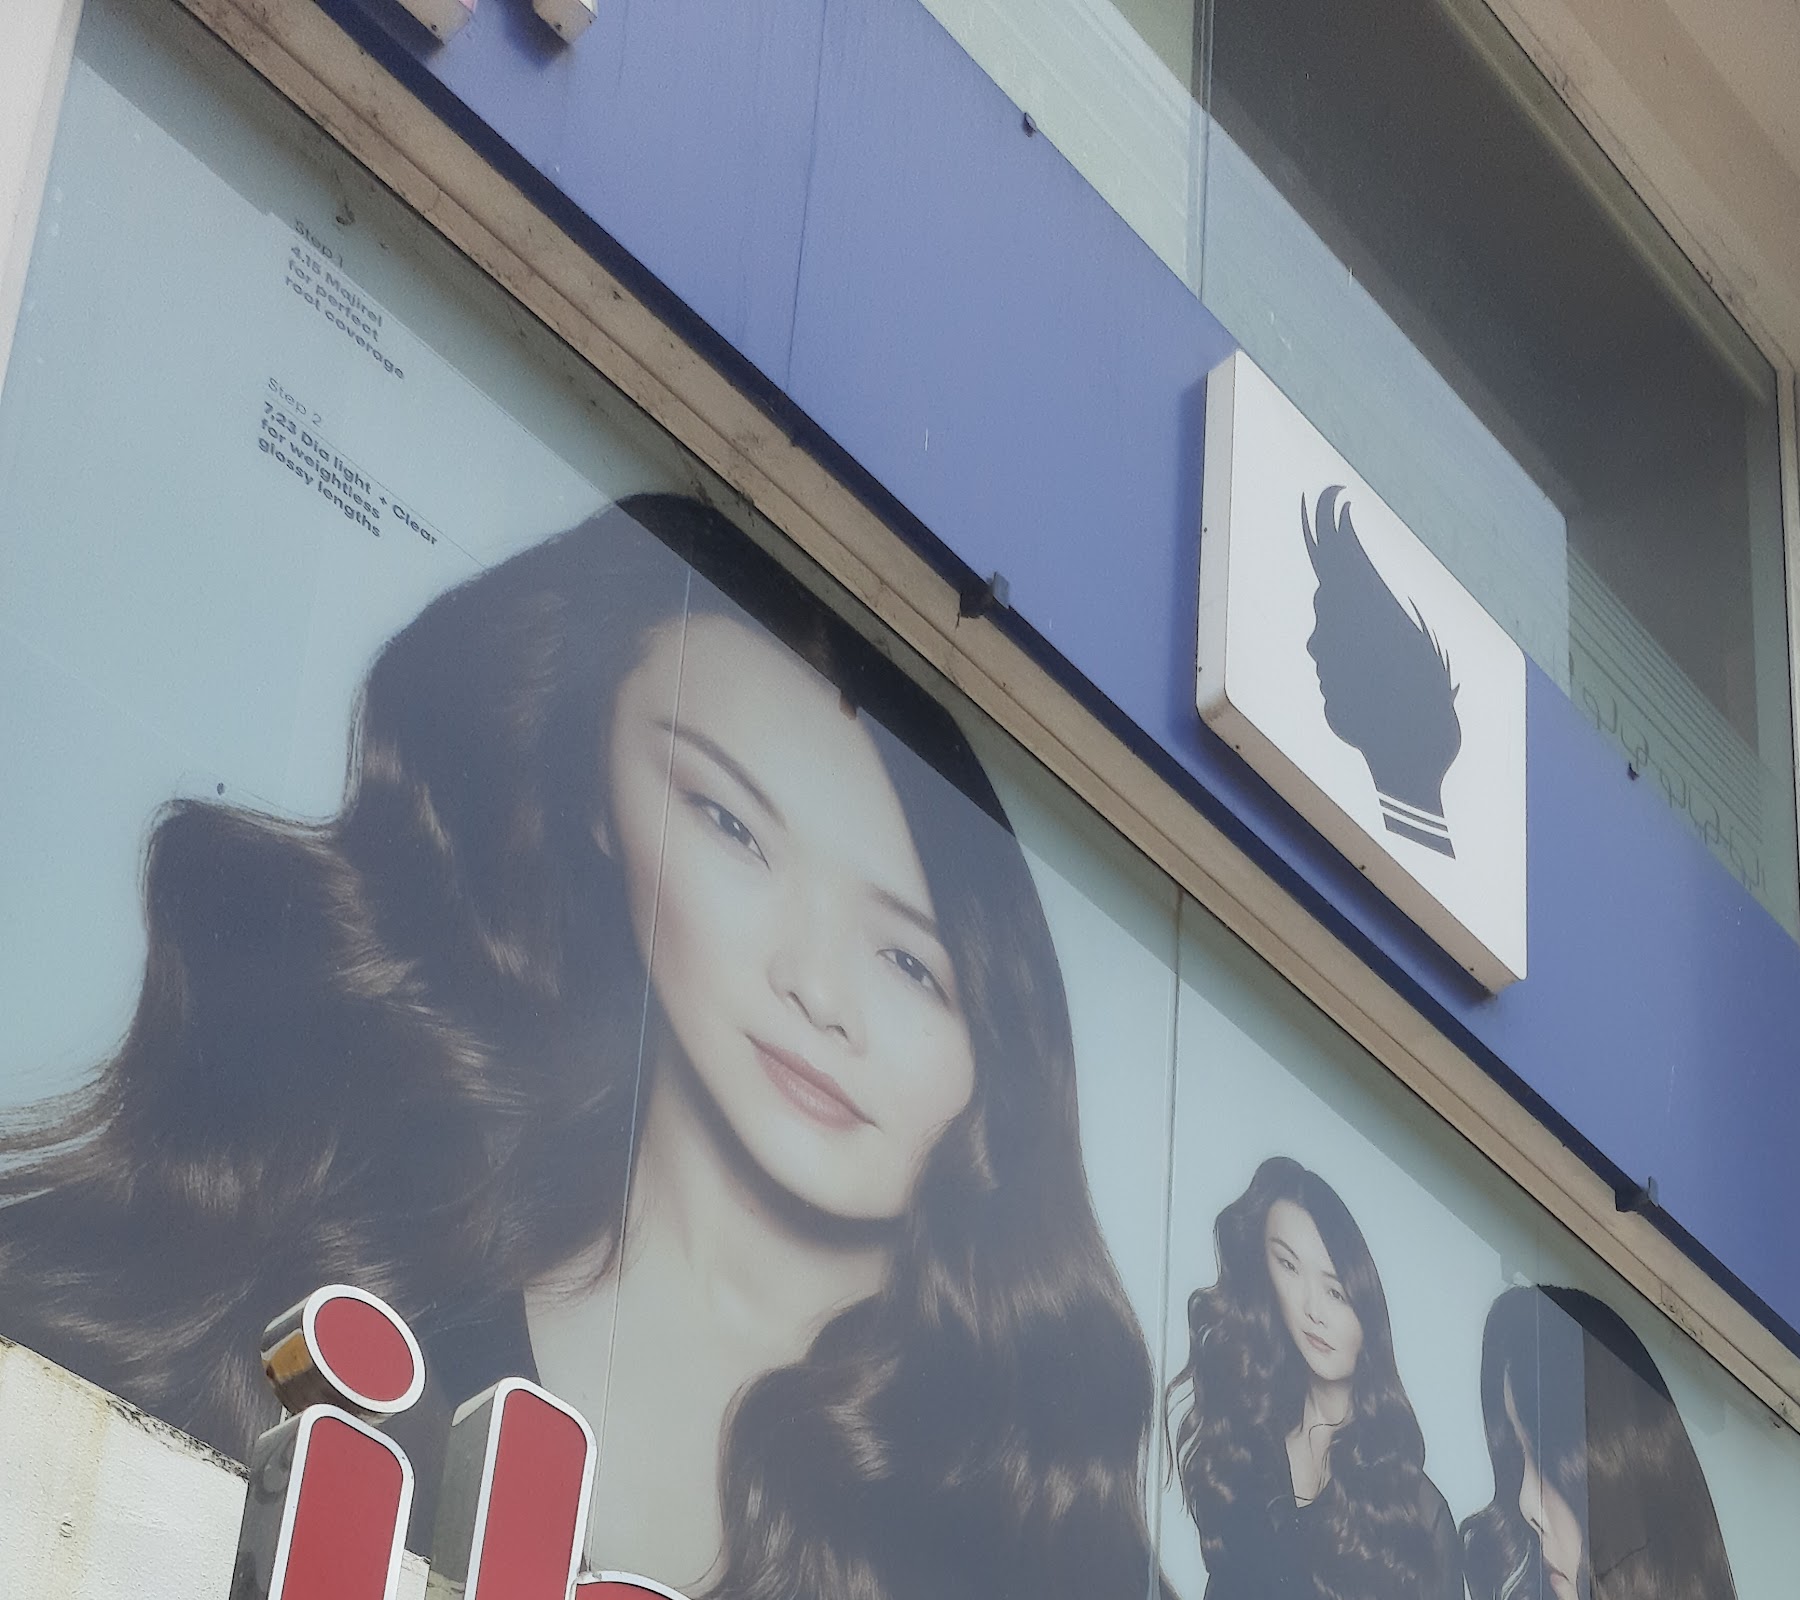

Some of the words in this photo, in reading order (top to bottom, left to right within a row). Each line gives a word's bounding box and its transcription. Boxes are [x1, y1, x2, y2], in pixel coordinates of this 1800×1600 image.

[294, 217, 334, 260] Step
[284, 275, 321, 312] root
[324, 309, 405, 380] coverage
[288, 259, 313, 285] for
[315, 284, 380, 343] perfect
[268, 377, 308, 416] Step
[311, 413, 323, 428] 2
[258, 437, 314, 485] glossy
[317, 480, 381, 539] lengths
[261, 418, 287, 444] for
[289, 441, 381, 520] weightless
[301, 431, 331, 463] Dia
[333, 456, 372, 495] light
[392, 504, 438, 546] Clear
